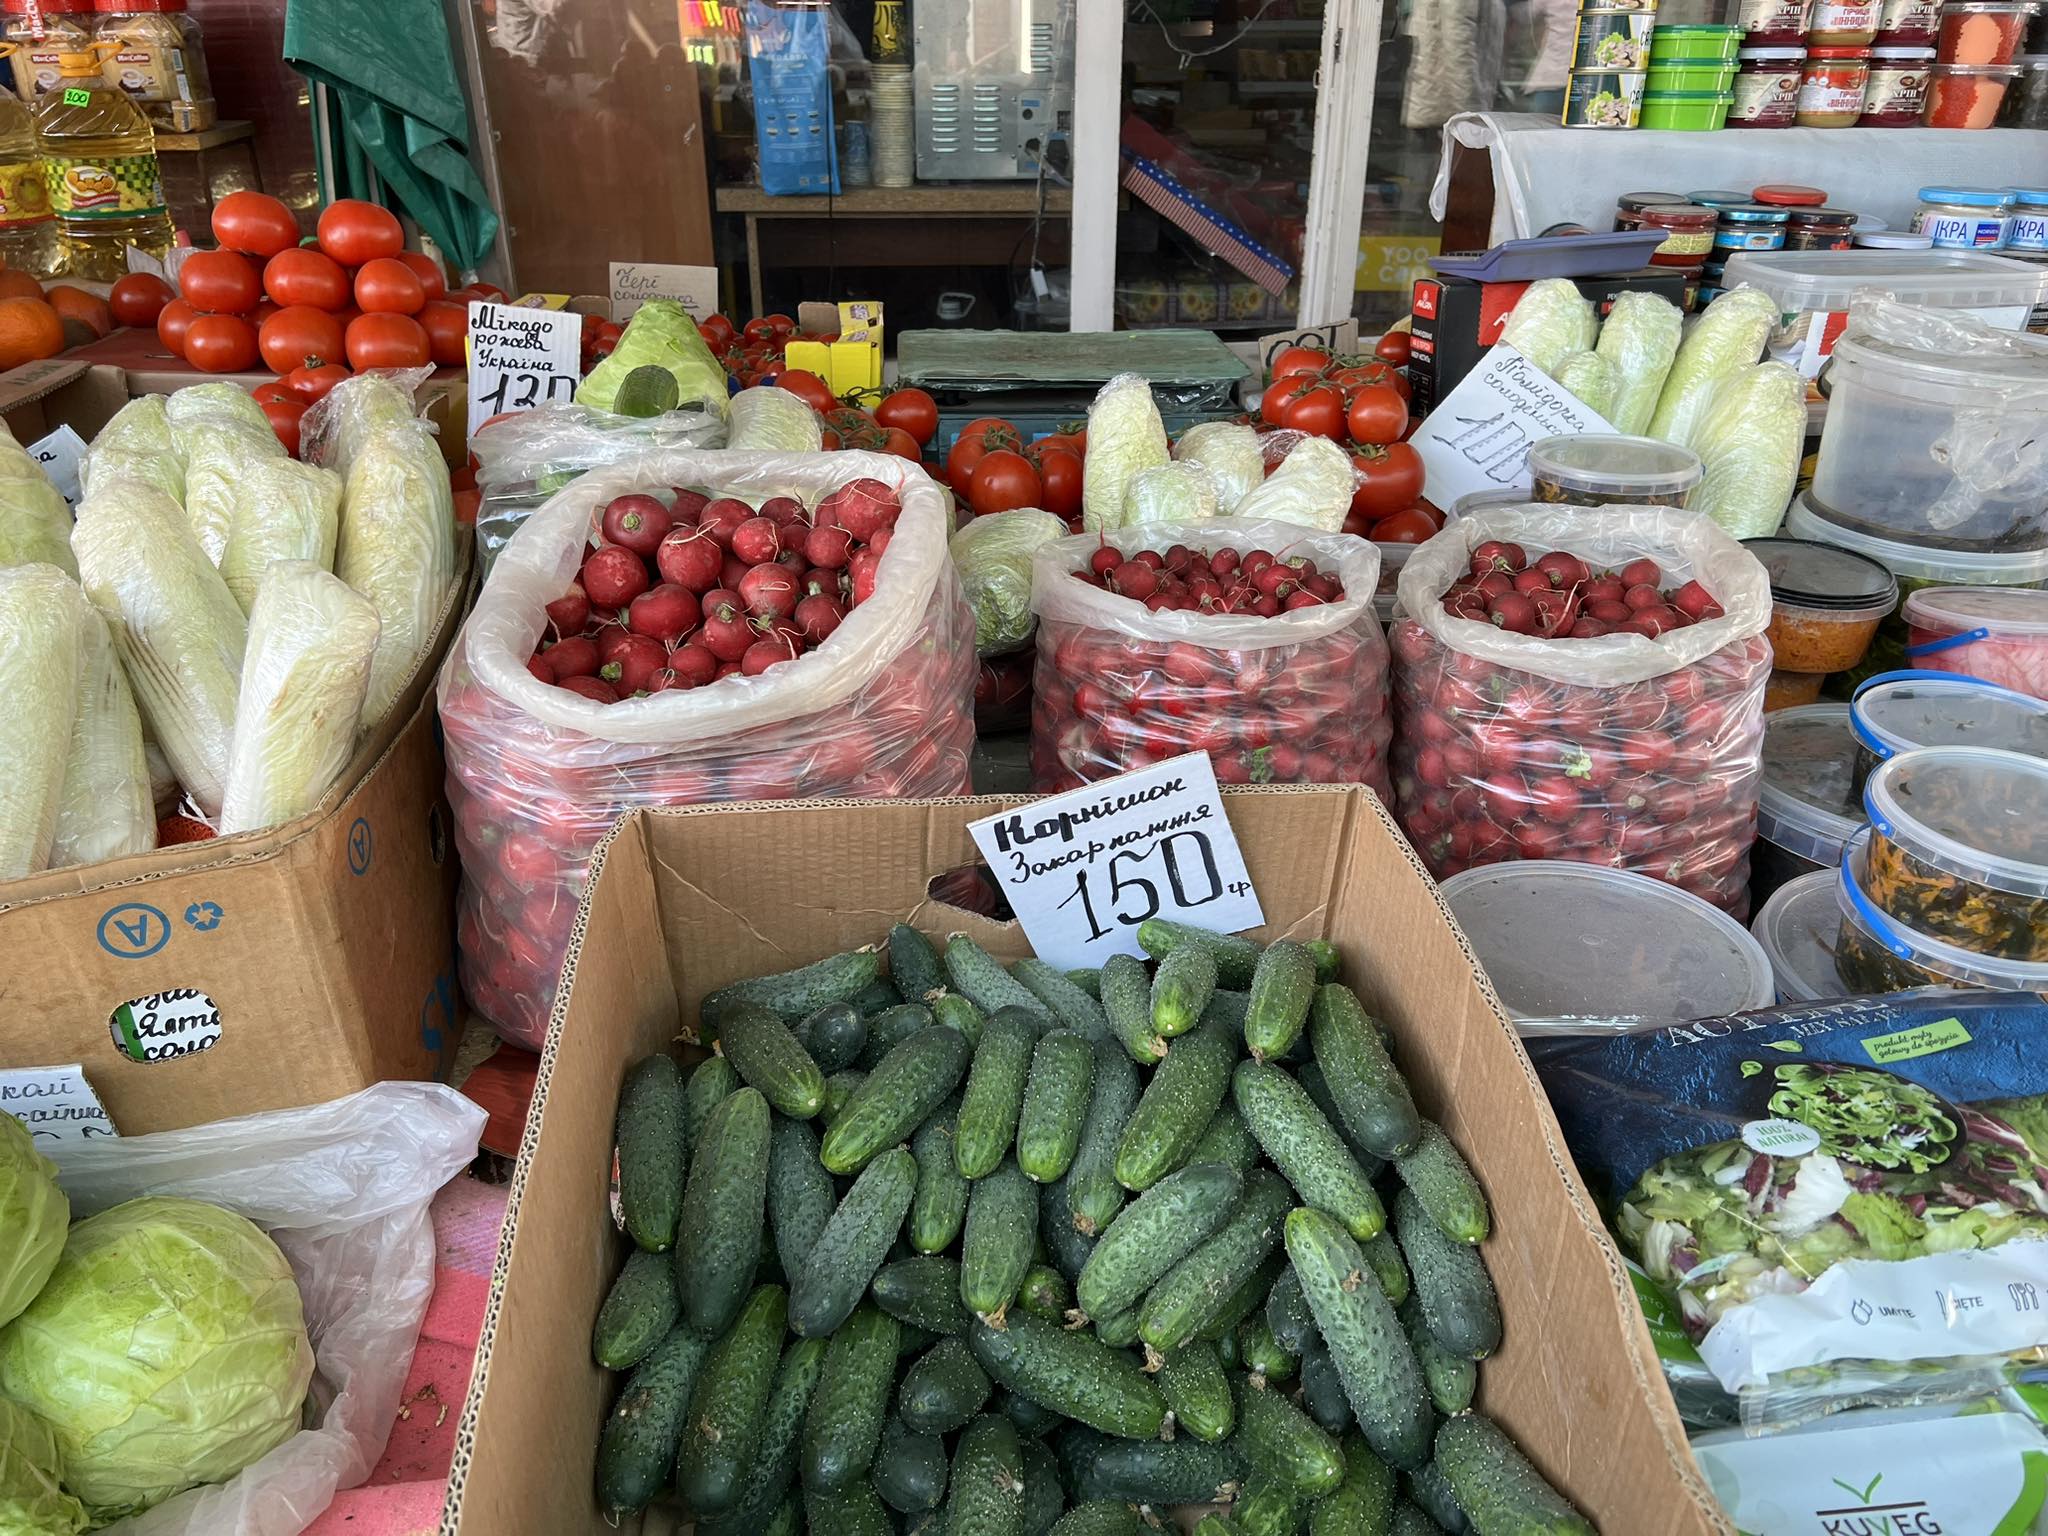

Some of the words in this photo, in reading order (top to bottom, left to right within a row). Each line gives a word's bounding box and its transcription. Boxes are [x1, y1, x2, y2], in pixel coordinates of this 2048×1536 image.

[479, 348, 556, 372] Україна
[994, 777, 1187, 852] Корнішон
[1010, 804, 1213, 883] Закарпаття
[1056, 830, 1224, 943] 150
[1873, 1034, 1908, 1052] produkt
[1878, 1046, 1910, 1058] gotowy
[1911, 1040, 1923, 1050] do
[1756, 1132, 1813, 1148] NATURAL
[1821, 1511, 1943, 1536] KUVEG
